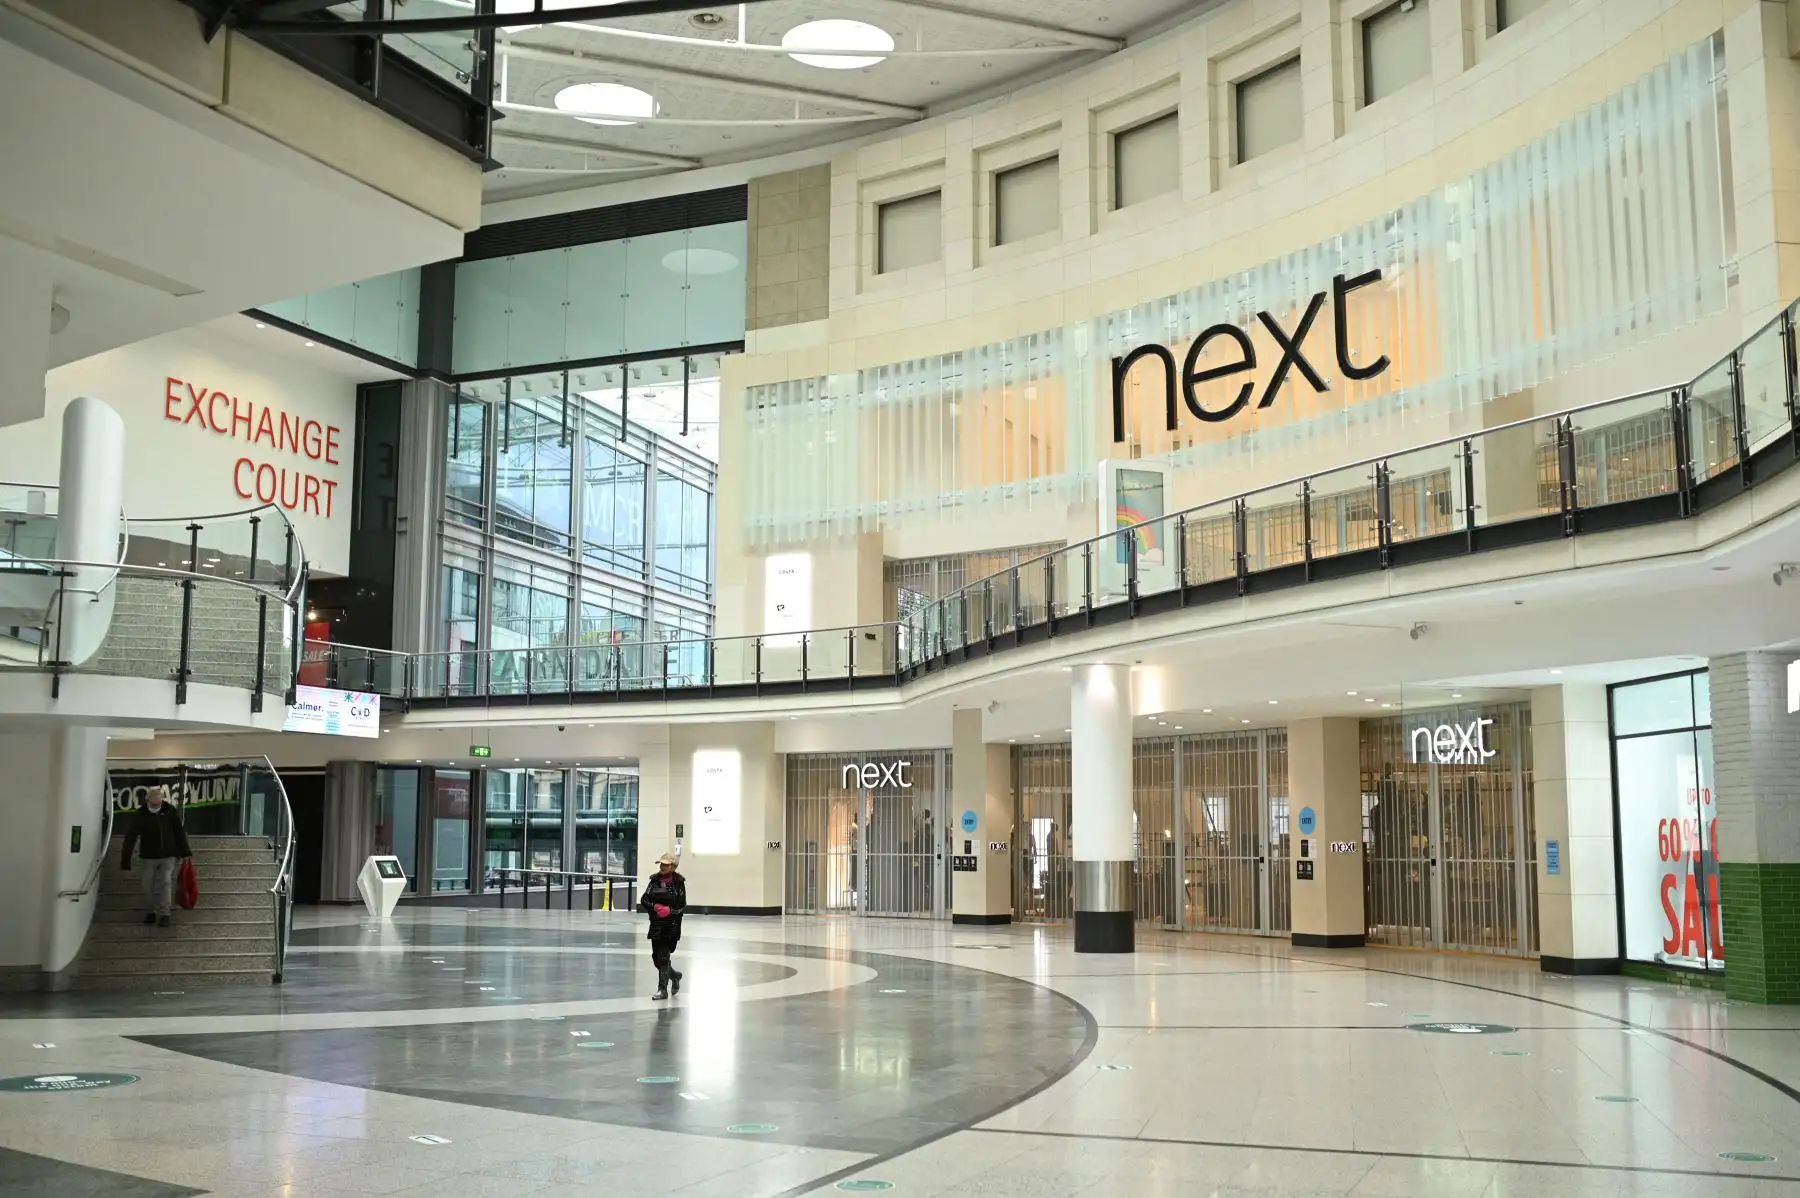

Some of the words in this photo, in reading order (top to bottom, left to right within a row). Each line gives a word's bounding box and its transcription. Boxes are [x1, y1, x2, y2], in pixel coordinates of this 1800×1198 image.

[1111, 269, 1391, 442] next
[164, 376, 340, 465] EXCHANGE
[234, 457, 338, 518] COURT
[1411, 716, 1497, 765] next
[842, 759, 913, 790] next
[1686, 788, 1696, 806] UP
[1301, 817, 1313, 825] ENTRY
[1331, 841, 1358, 853] next
